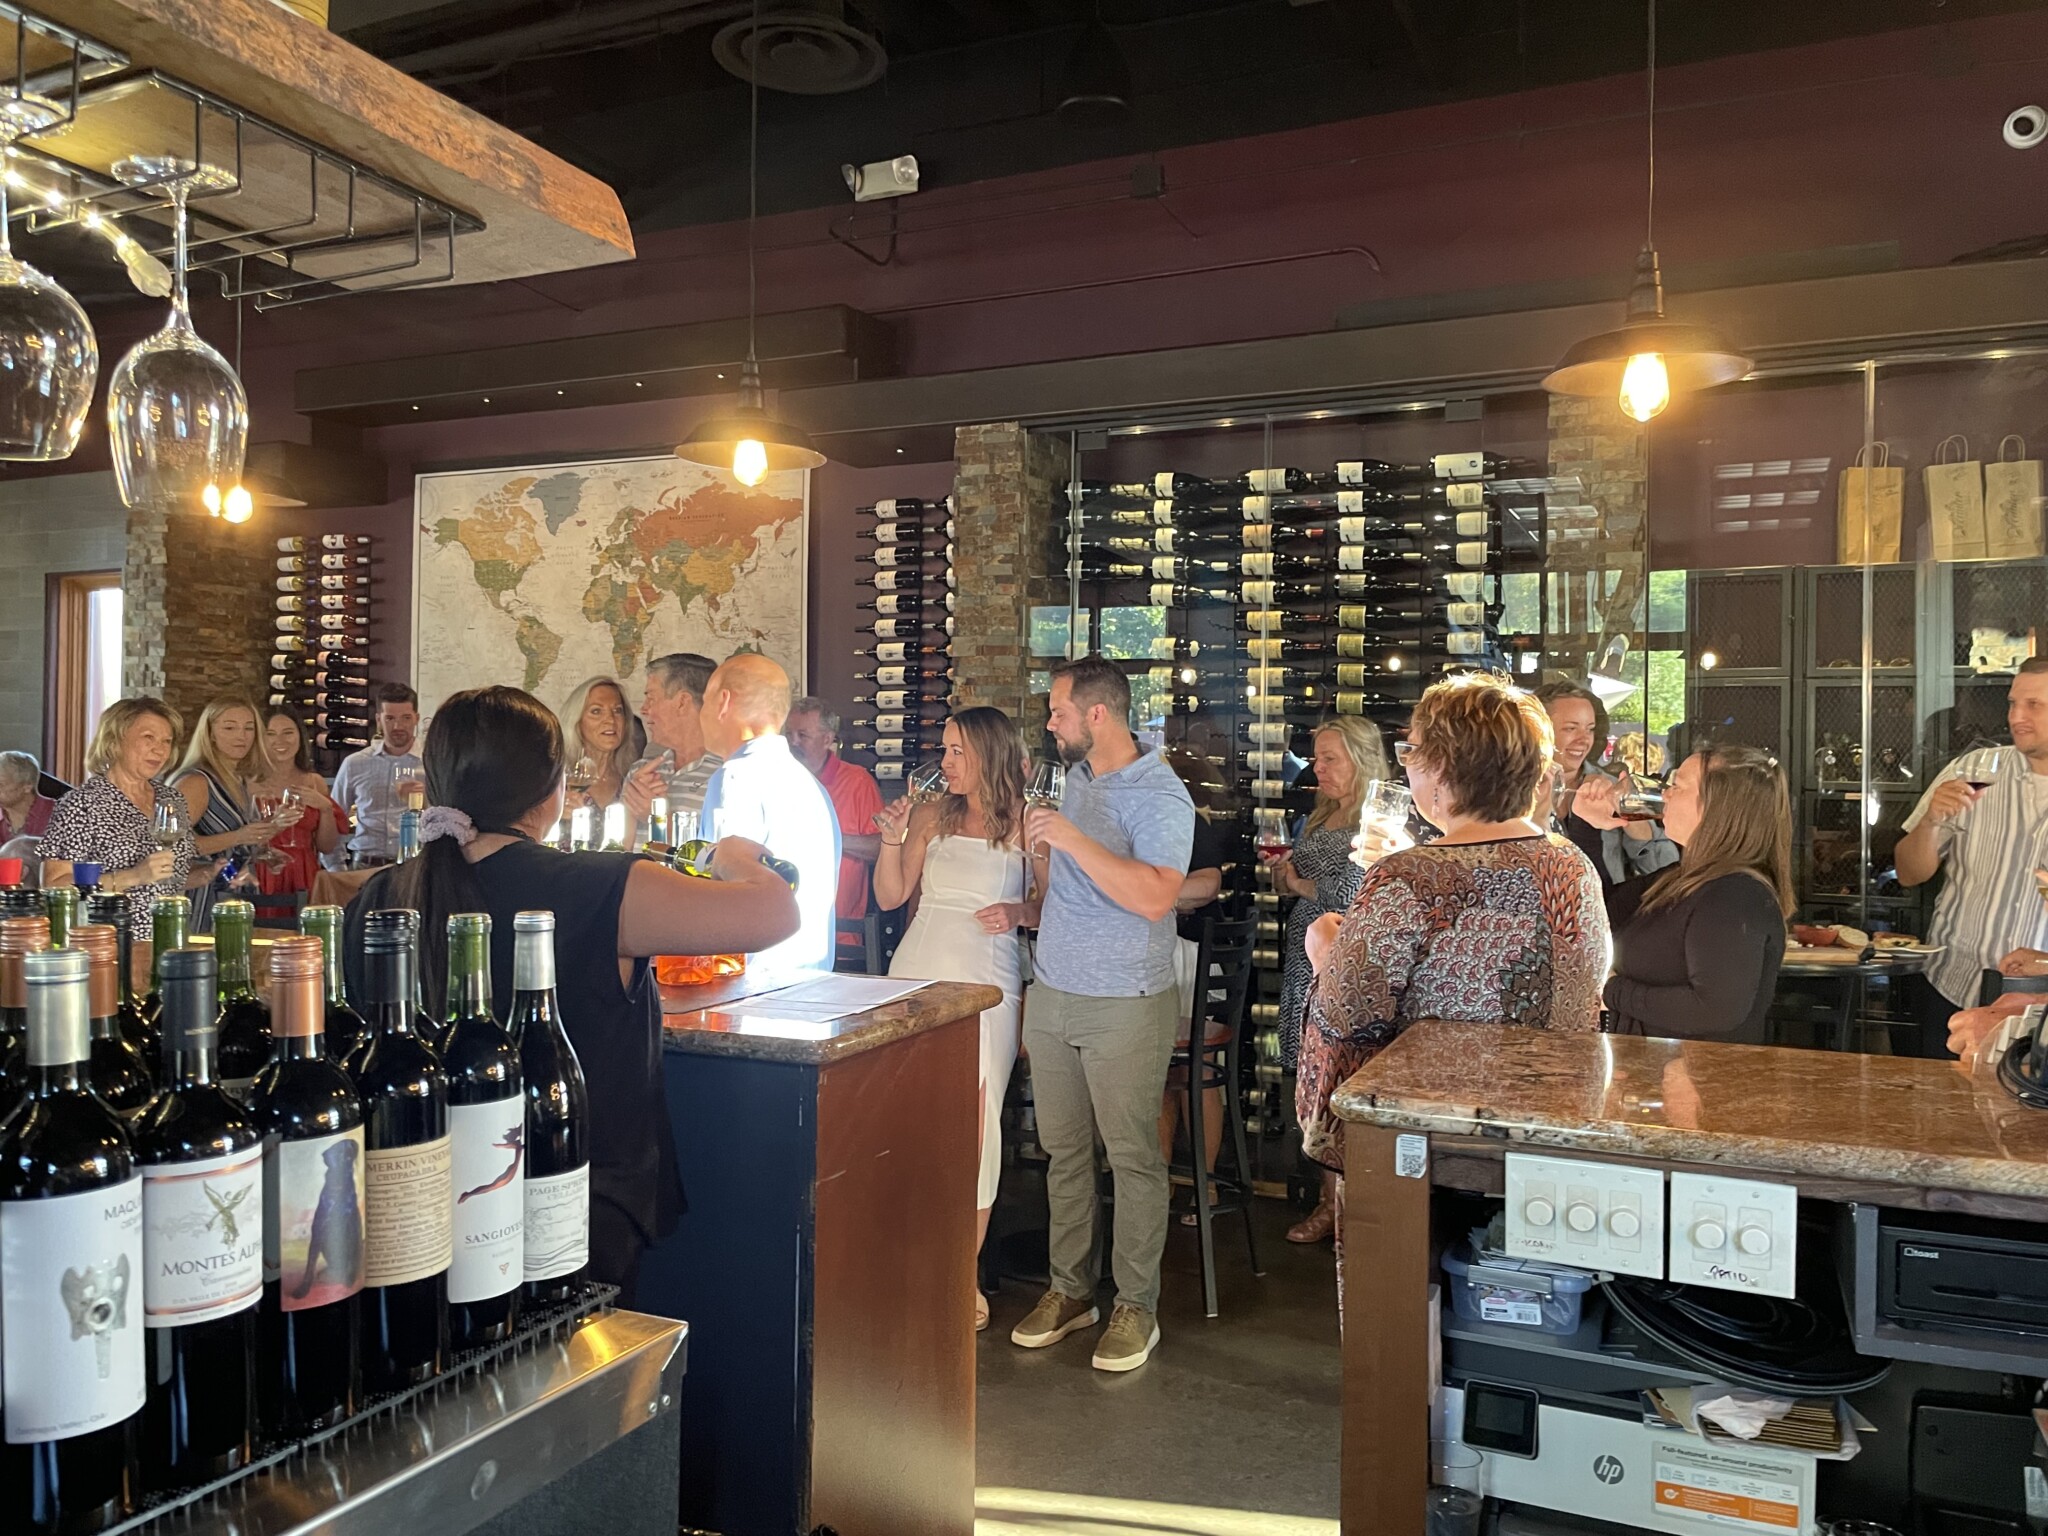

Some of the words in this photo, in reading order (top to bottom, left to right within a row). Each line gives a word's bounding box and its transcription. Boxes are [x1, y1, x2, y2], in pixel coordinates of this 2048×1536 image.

[367, 1159, 417, 1173] MERKIN
[529, 1185, 560, 1196] PAGE
[161, 1252, 236, 1277] MONTES
[1710, 1265, 1748, 1283] PATIO
